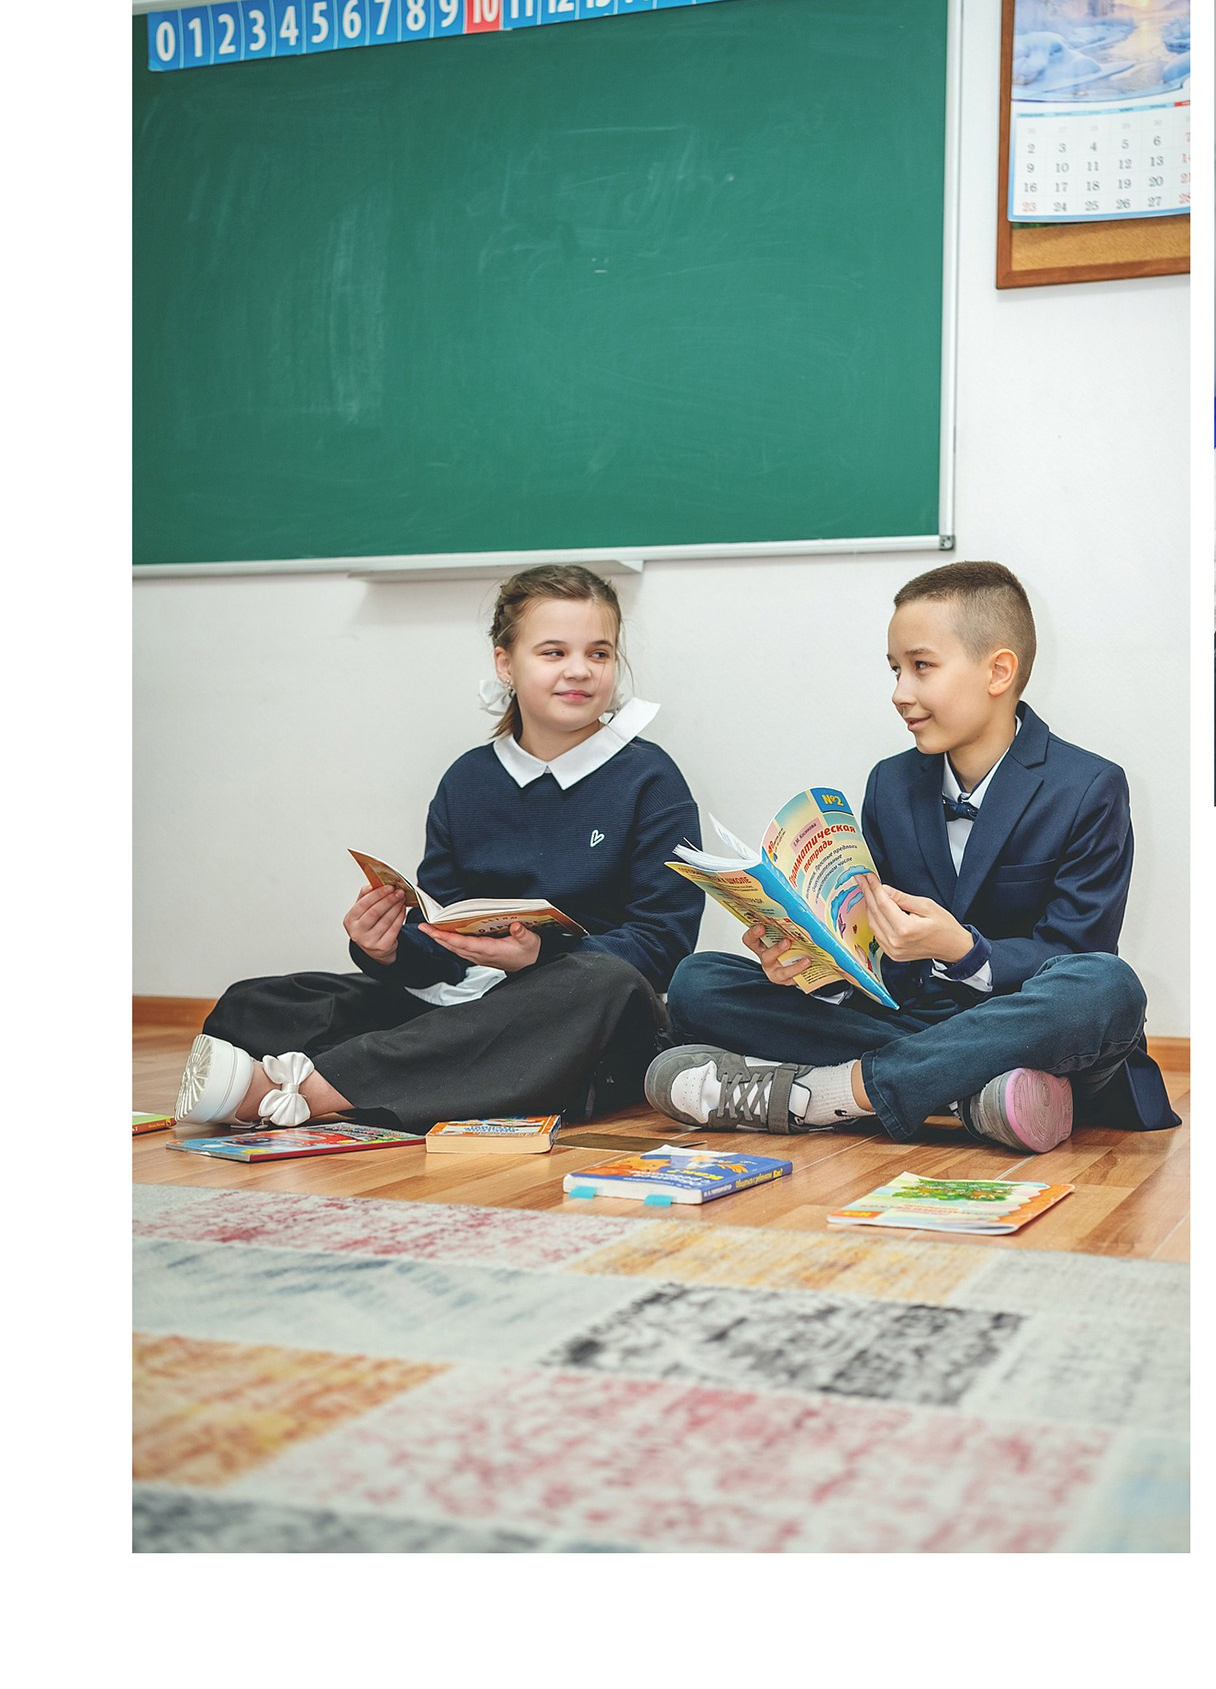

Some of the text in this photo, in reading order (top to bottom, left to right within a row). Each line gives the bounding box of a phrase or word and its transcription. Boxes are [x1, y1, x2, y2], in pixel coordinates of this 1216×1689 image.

[156, 21, 176, 62] 0
[188, 17, 203, 58] 1
[218, 13, 236, 55] 2
[249, 9, 267, 52] 3
[279, 5, 299, 47] 4
[311, 1, 329, 44] 5
[803, 839, 833, 873] тетрадь
